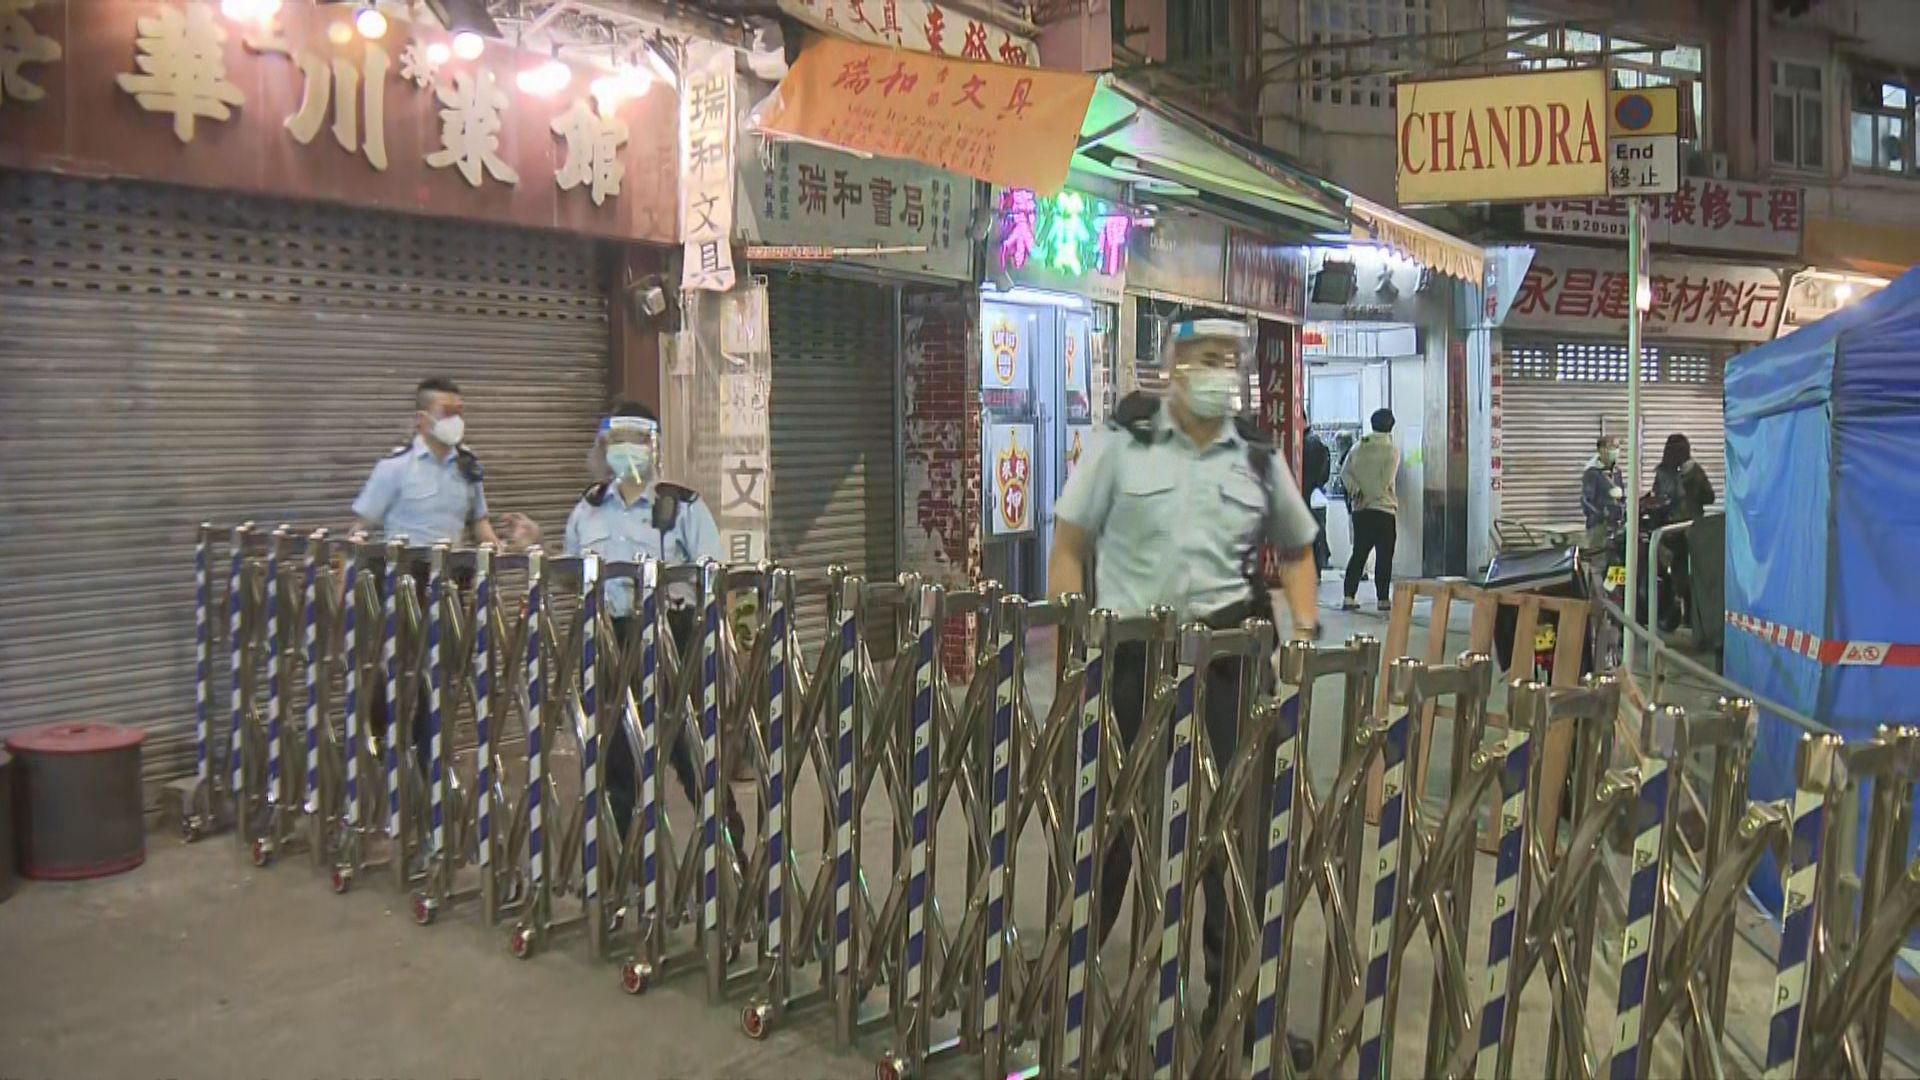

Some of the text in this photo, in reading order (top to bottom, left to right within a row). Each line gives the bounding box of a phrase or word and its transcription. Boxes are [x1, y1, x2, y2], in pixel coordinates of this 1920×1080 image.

[1401, 99, 1602, 175] CHANDRA
[1616, 143, 1653, 160] End
[690, 75, 731, 286] 瑞和文具
[798, 163, 925, 233] 瑞和書局
[1610, 166, 1660, 188] 終止
